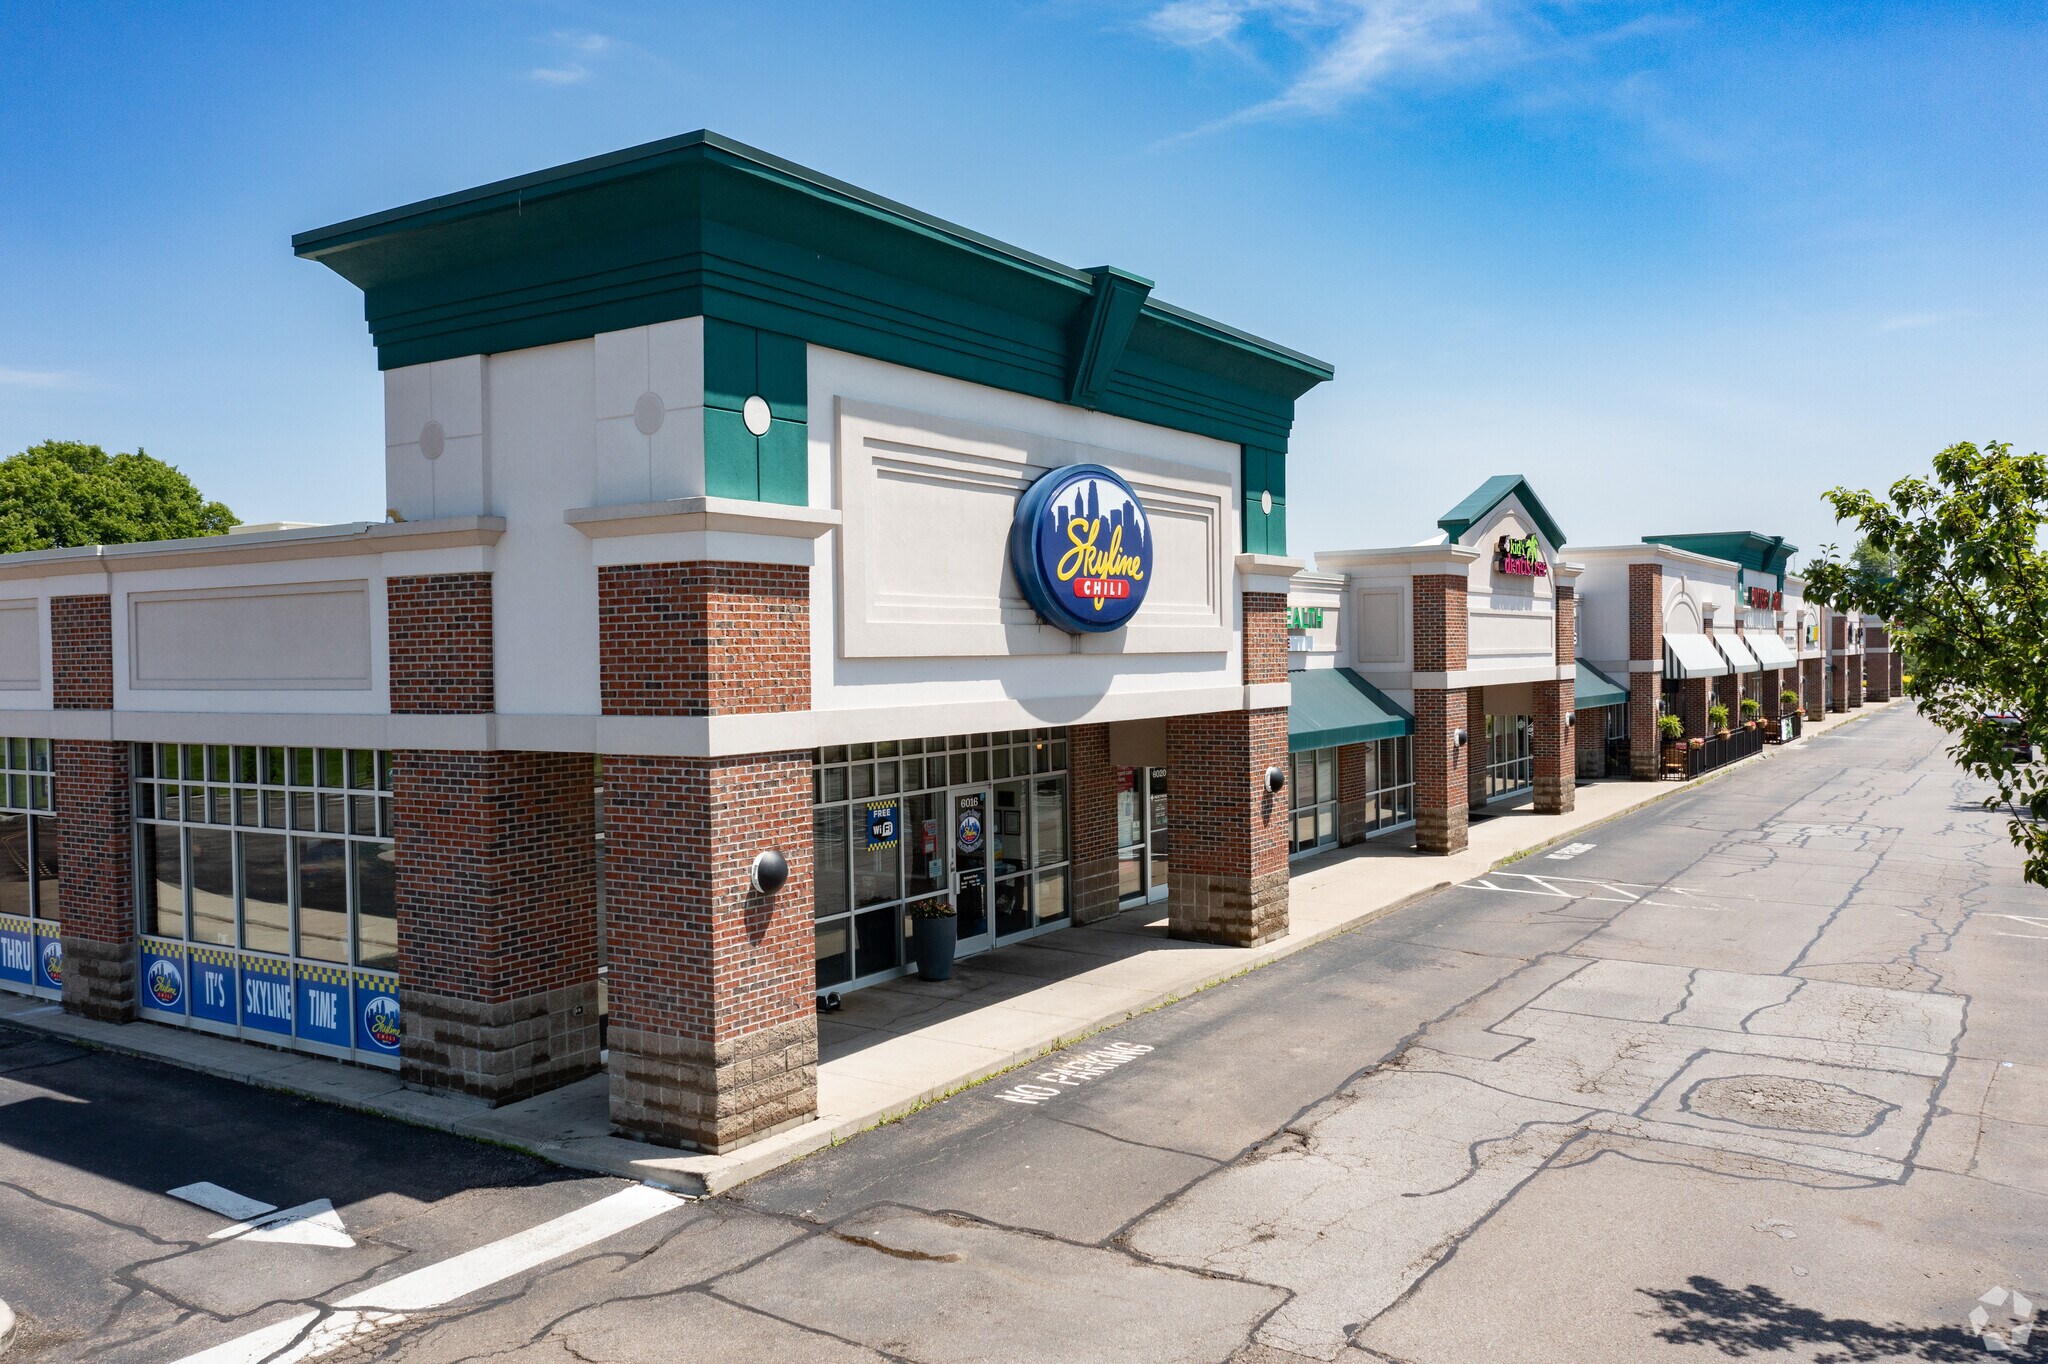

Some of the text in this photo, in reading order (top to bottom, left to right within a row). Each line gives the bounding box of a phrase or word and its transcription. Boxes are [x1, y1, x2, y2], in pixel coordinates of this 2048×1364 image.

[1510, 538, 1525, 555] kid's
[1057, 518, 1144, 611] Skyline
[1083, 580, 1122, 596] CHILI
[1286, 607, 1324, 629] EALTH
[873, 809, 891, 818] FREE
[960, 797, 979, 808] 6016
[1, 937, 31, 971] THRU
[205, 971, 337, 1029] IT'S SKYLINE TIME
[994, 1042, 1155, 1105] NO PARKING
